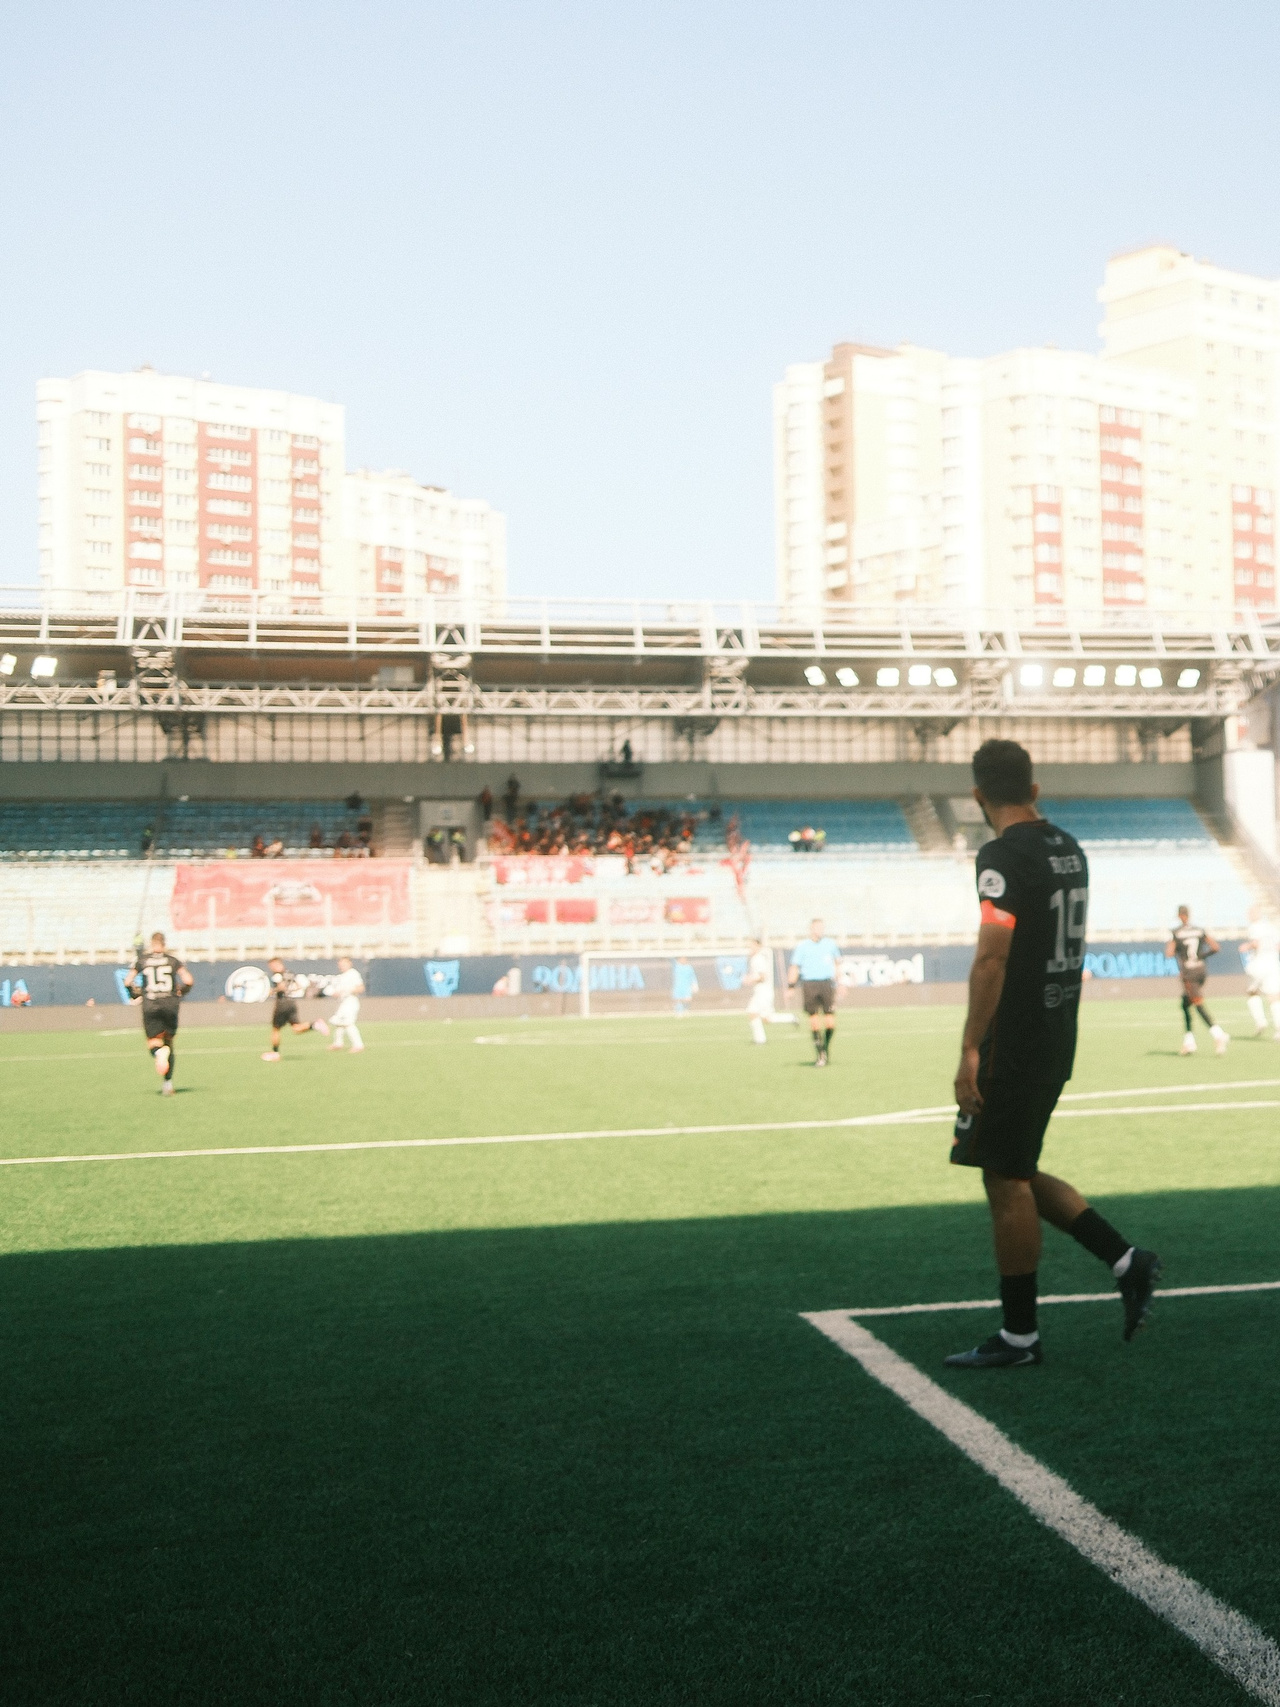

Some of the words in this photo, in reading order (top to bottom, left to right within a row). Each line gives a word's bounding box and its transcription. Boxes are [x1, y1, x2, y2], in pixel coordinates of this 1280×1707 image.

[1047, 887, 1088, 973] 19
[1183, 937, 1200, 962] 7
[143, 965, 173, 993] 15
